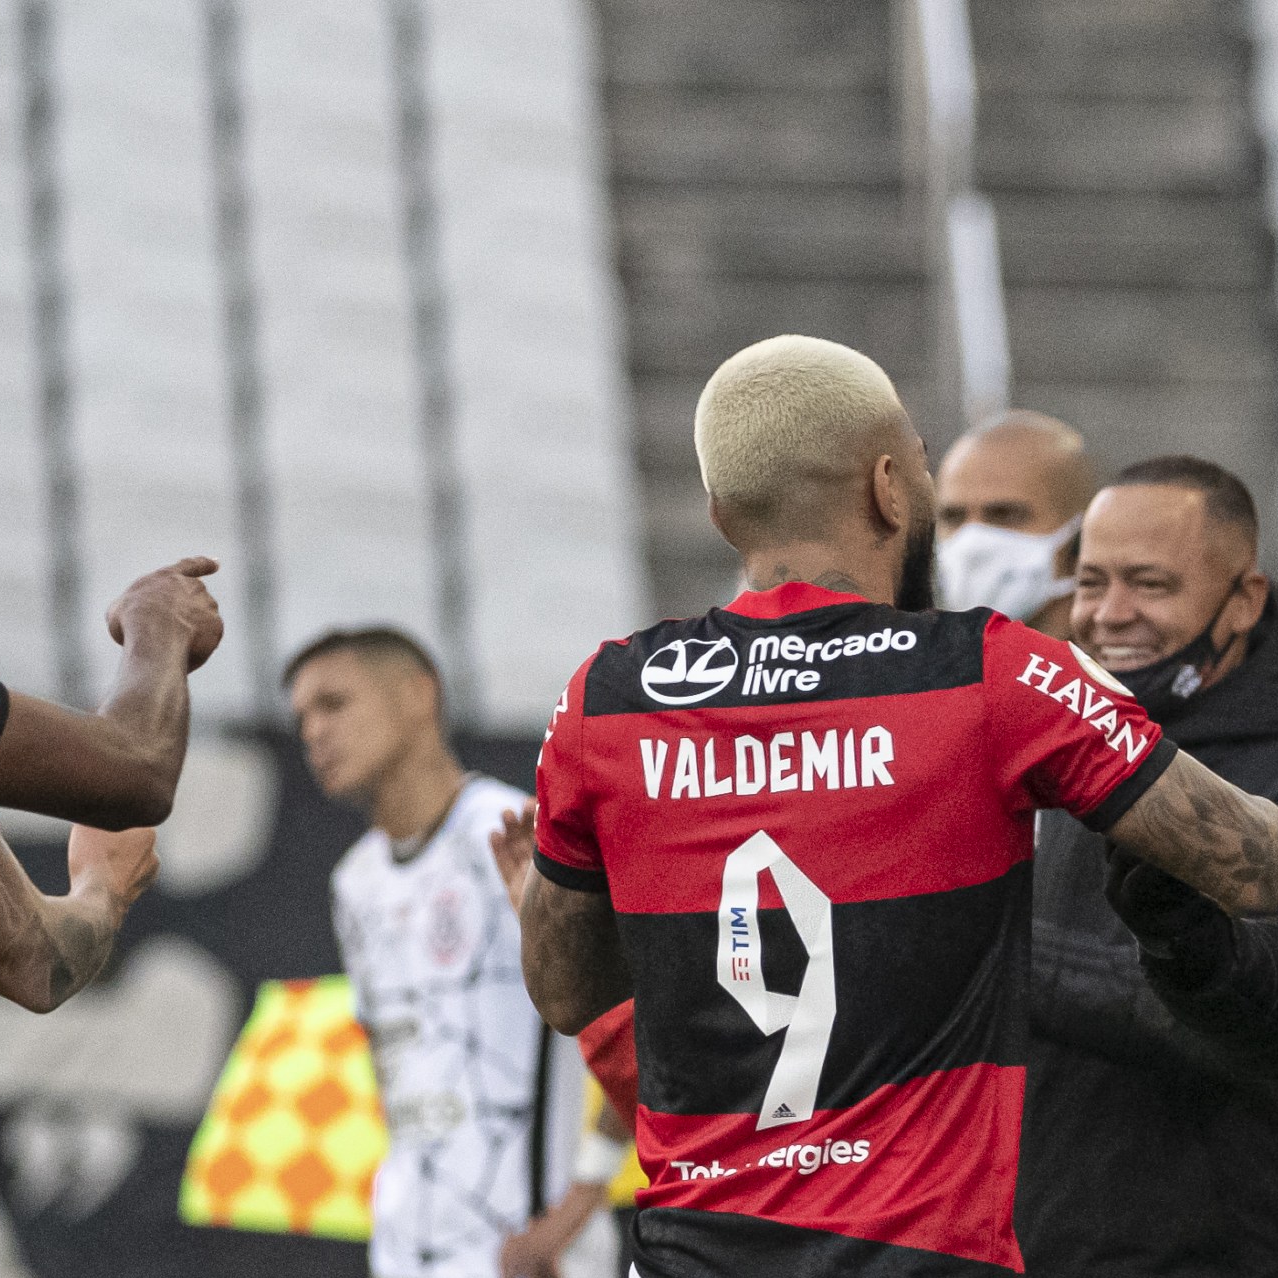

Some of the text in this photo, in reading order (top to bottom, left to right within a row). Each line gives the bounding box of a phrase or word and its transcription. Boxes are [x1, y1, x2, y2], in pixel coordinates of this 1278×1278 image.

[748, 628, 917, 666] mercado
[741, 663, 821, 695] livre
[1017, 653, 1150, 763] HAVAN
[639, 725, 895, 800] VALDEMIR
[731, 907, 747, 952] TIM
[717, 829, 837, 1132] 9
